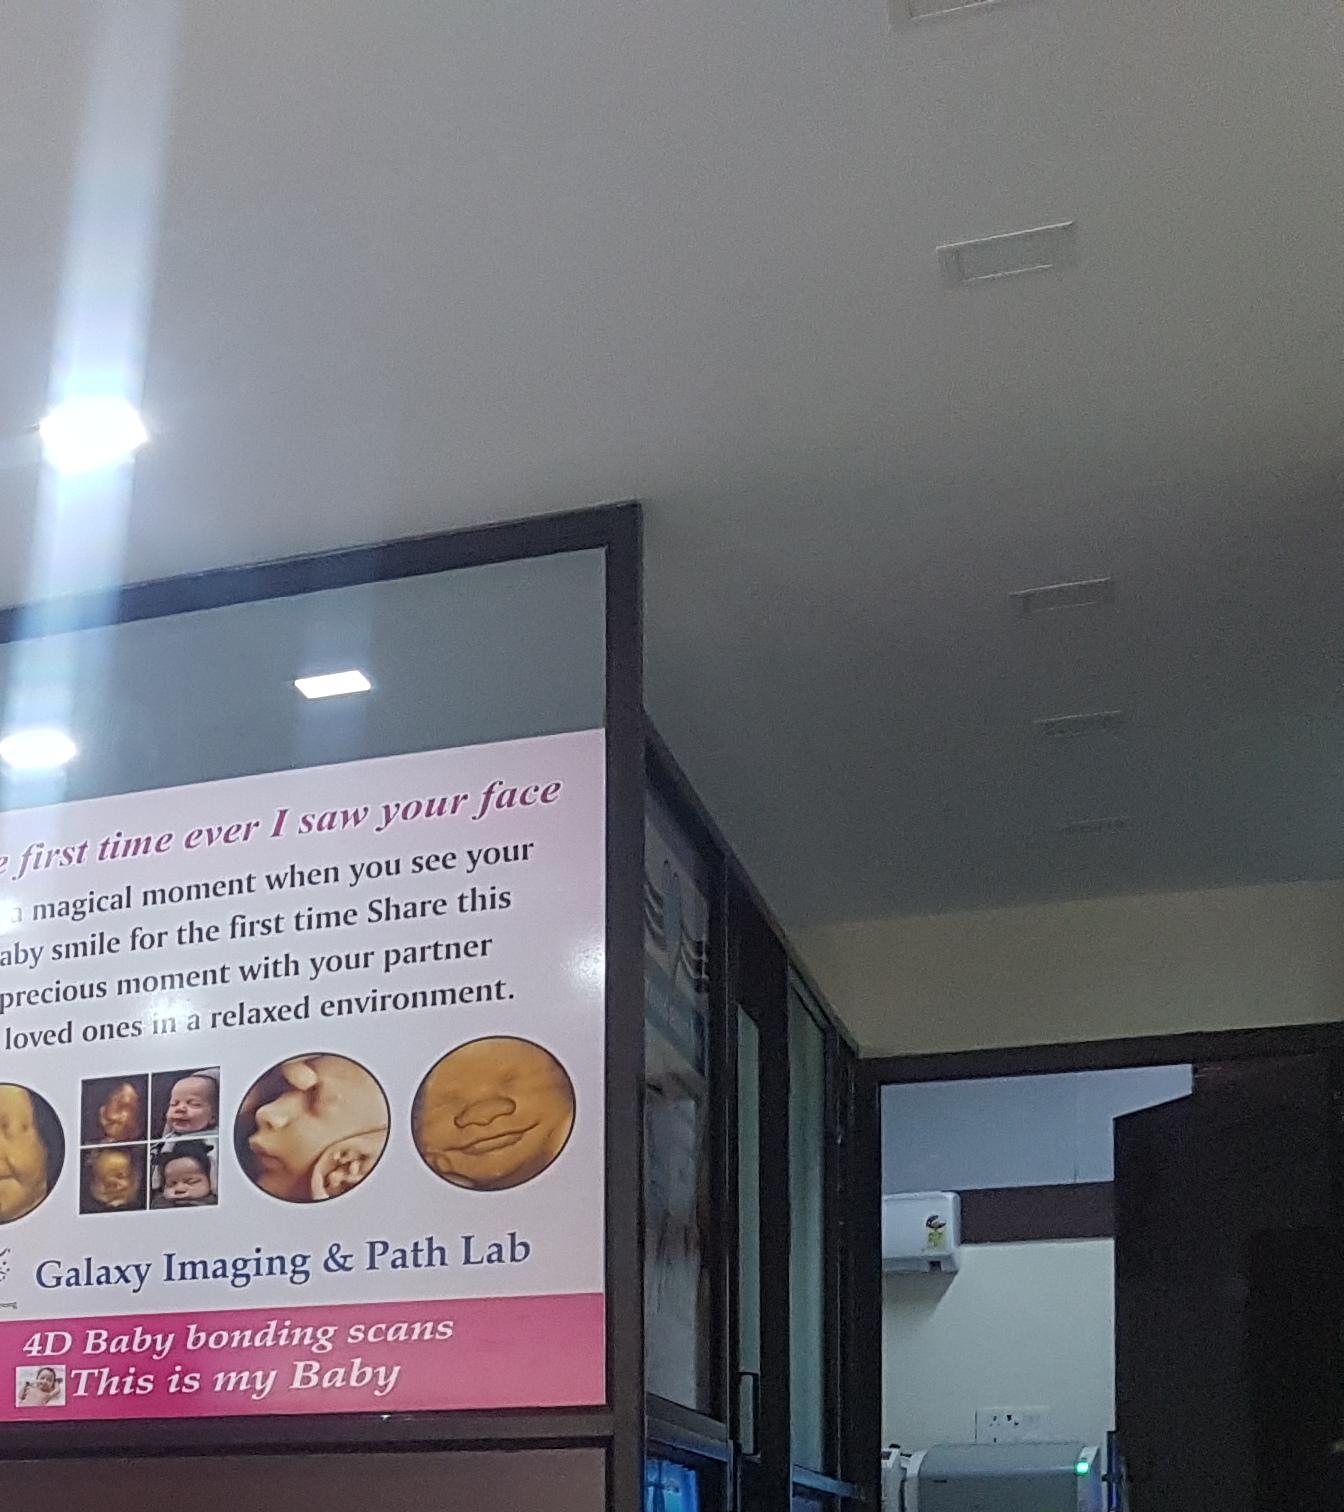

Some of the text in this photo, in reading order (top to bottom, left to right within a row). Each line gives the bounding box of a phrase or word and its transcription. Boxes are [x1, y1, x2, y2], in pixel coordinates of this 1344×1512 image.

[12, 841, 89, 881] first
[97, 829, 174, 862] time
[184, 819, 260, 850] ever
[271, 808, 289, 837] I
[298, 806, 369, 835] saw
[375, 793, 468, 831] your
[472, 779, 562, 820] face
[32, 885, 132, 921] magical
[142, 873, 256, 907] moment
[265, 864, 340, 891] when
[349, 856, 402, 888] you
[411, 850, 458, 875] see
[465, 842, 534, 877] your
[52, 932, 121, 961] smile
[129, 927, 168, 952] for
[177, 920, 220, 946] the
[229, 913, 285, 940] first
[294, 906, 359, 933] time
[367, 893, 447, 924] Share
[457, 886, 512, 914] this
[0, 935, 493, 1015] precious moment with your partner
[5, 1021, 73, 1051] loved
[82, 1019, 142, 1043] ones
[152, 1012, 177, 1036] in
[186, 1014, 201, 1032] a
[211, 995, 310, 1029] relaxed
[320, 978, 515, 1017] environment.
[36, 1230, 531, 1292] Galaxy Imaging & Path Lab
[23, 1316, 454, 1359] 4D Baby bonding scans
[69, 1358, 400, 1400] This is my Baby
